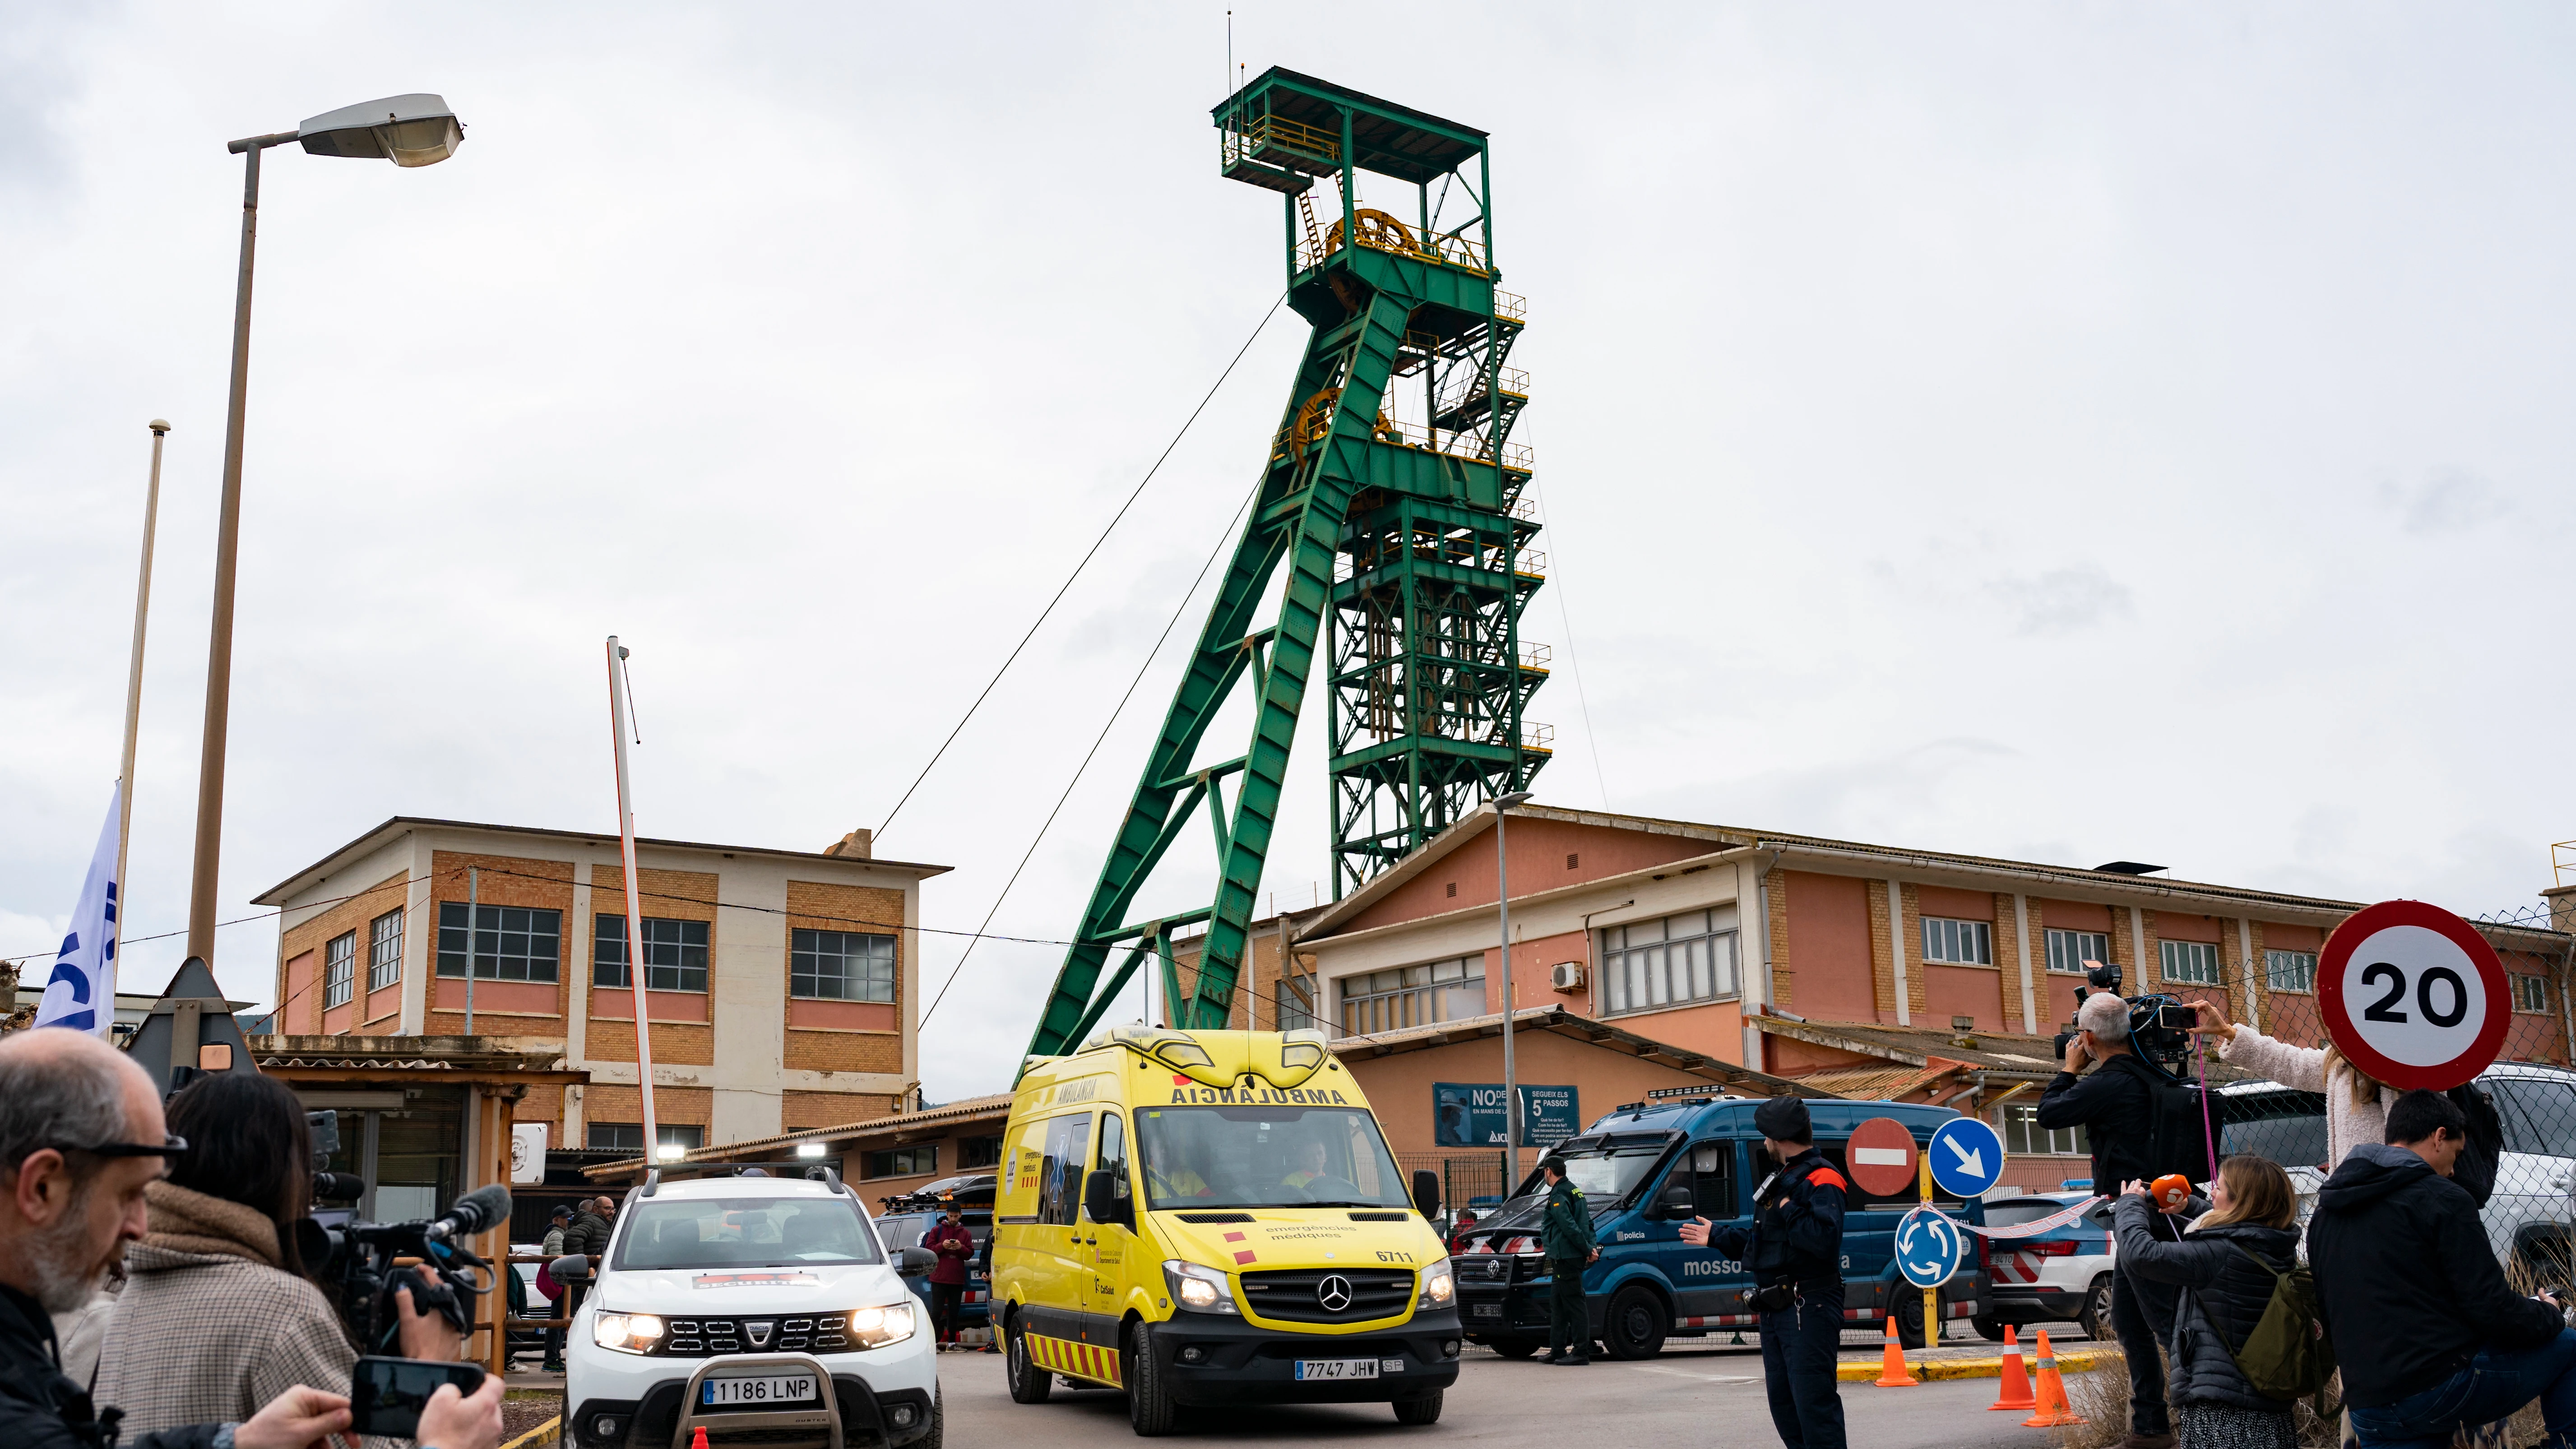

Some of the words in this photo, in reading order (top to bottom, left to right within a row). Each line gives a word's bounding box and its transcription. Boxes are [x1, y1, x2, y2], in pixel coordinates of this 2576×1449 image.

[2361, 962, 2467, 1028] 20
[1473, 1090, 1496, 1106] NO
[1533, 1100, 1542, 1116] 5
[1624, 1231, 1645, 1241] policia
[1376, 1251, 1413, 1263] 6711
[1996, 1255, 2012, 1264] 9410
[1684, 1260, 1747, 1276] mosso
[699, 1280, 814, 1289] SECURIT
[1101, 1285, 1114, 1295] CatSalut
[1307, 1362, 1344, 1377] 7747
[1350, 1361, 1375, 1376] JHW
[1385, 1361, 1402, 1370] SP
[720, 1381, 766, 1400] 1186
[774, 1380, 809, 1398] LNP
